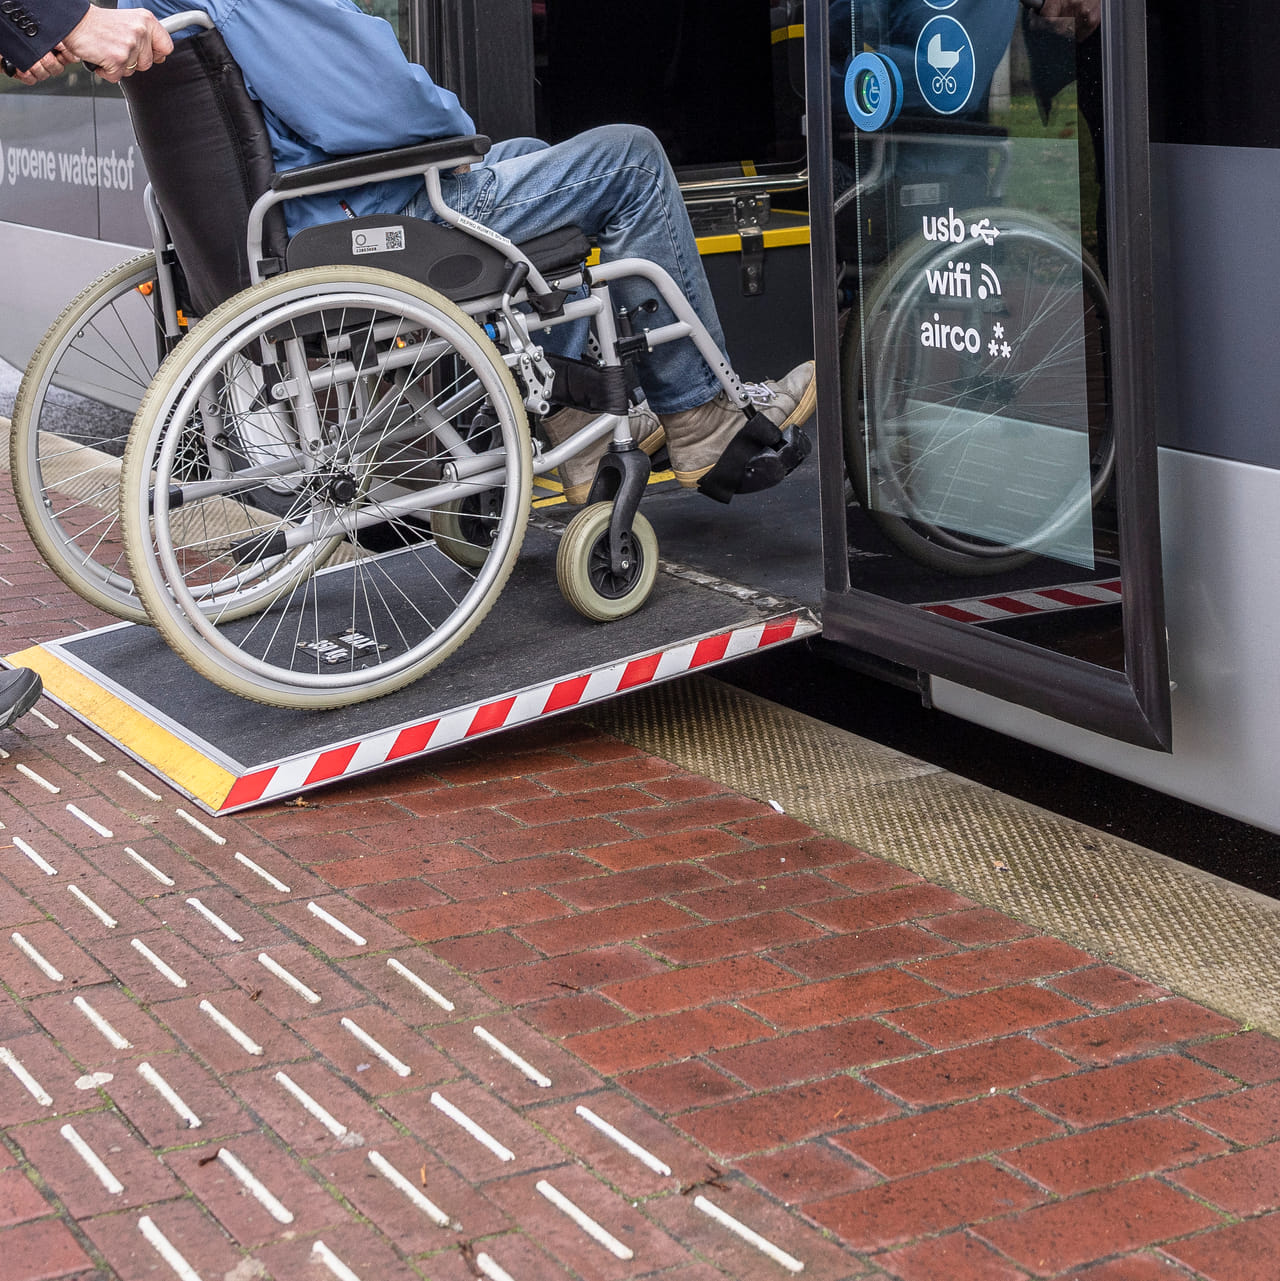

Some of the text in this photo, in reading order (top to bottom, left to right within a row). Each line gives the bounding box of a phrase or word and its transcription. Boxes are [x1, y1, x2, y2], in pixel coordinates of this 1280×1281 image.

[7, 145, 135, 191] groene waterstof
[923, 207, 965, 244] usb
[925, 262, 971, 299] wifi
[920, 313, 981, 355] airco
